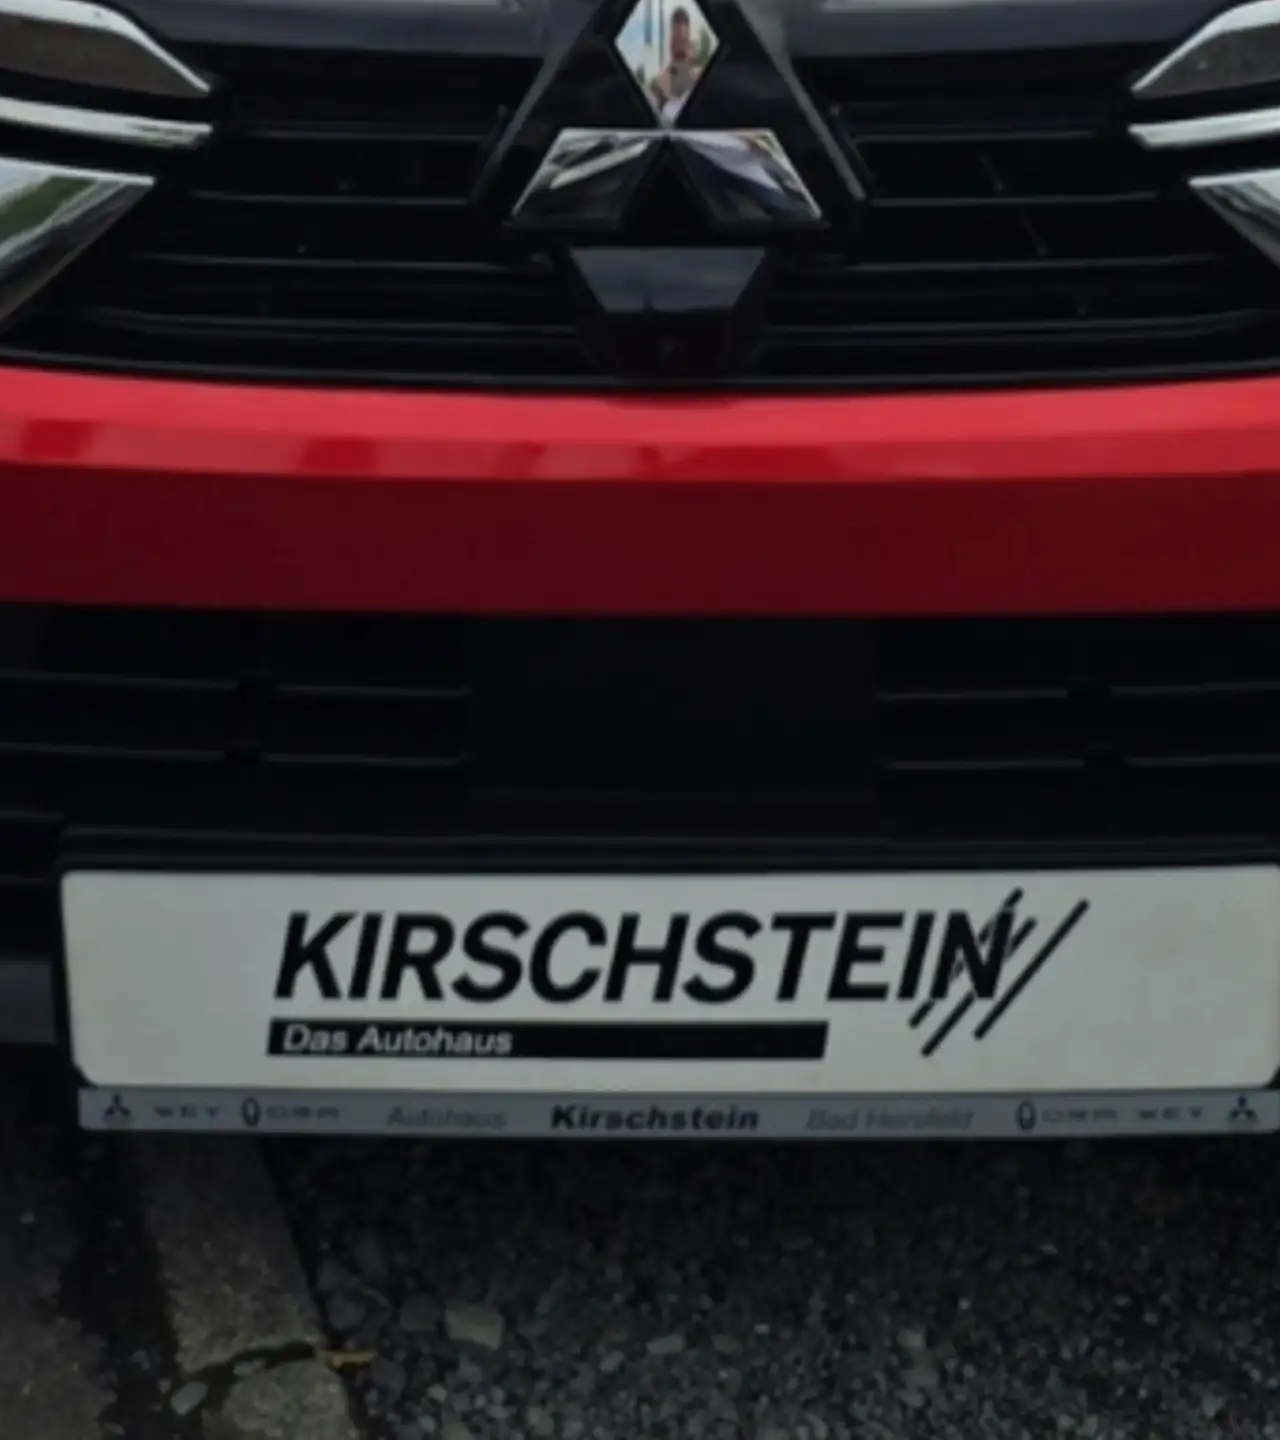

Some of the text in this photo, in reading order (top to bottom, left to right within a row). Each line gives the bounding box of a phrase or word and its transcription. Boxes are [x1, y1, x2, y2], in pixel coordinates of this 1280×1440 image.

[273, 910, 1016, 1003] KIRSCHSTEIN
[282, 1023, 514, 1055] Das Autohaus
[550, 1103, 762, 1132] Kirschstein
